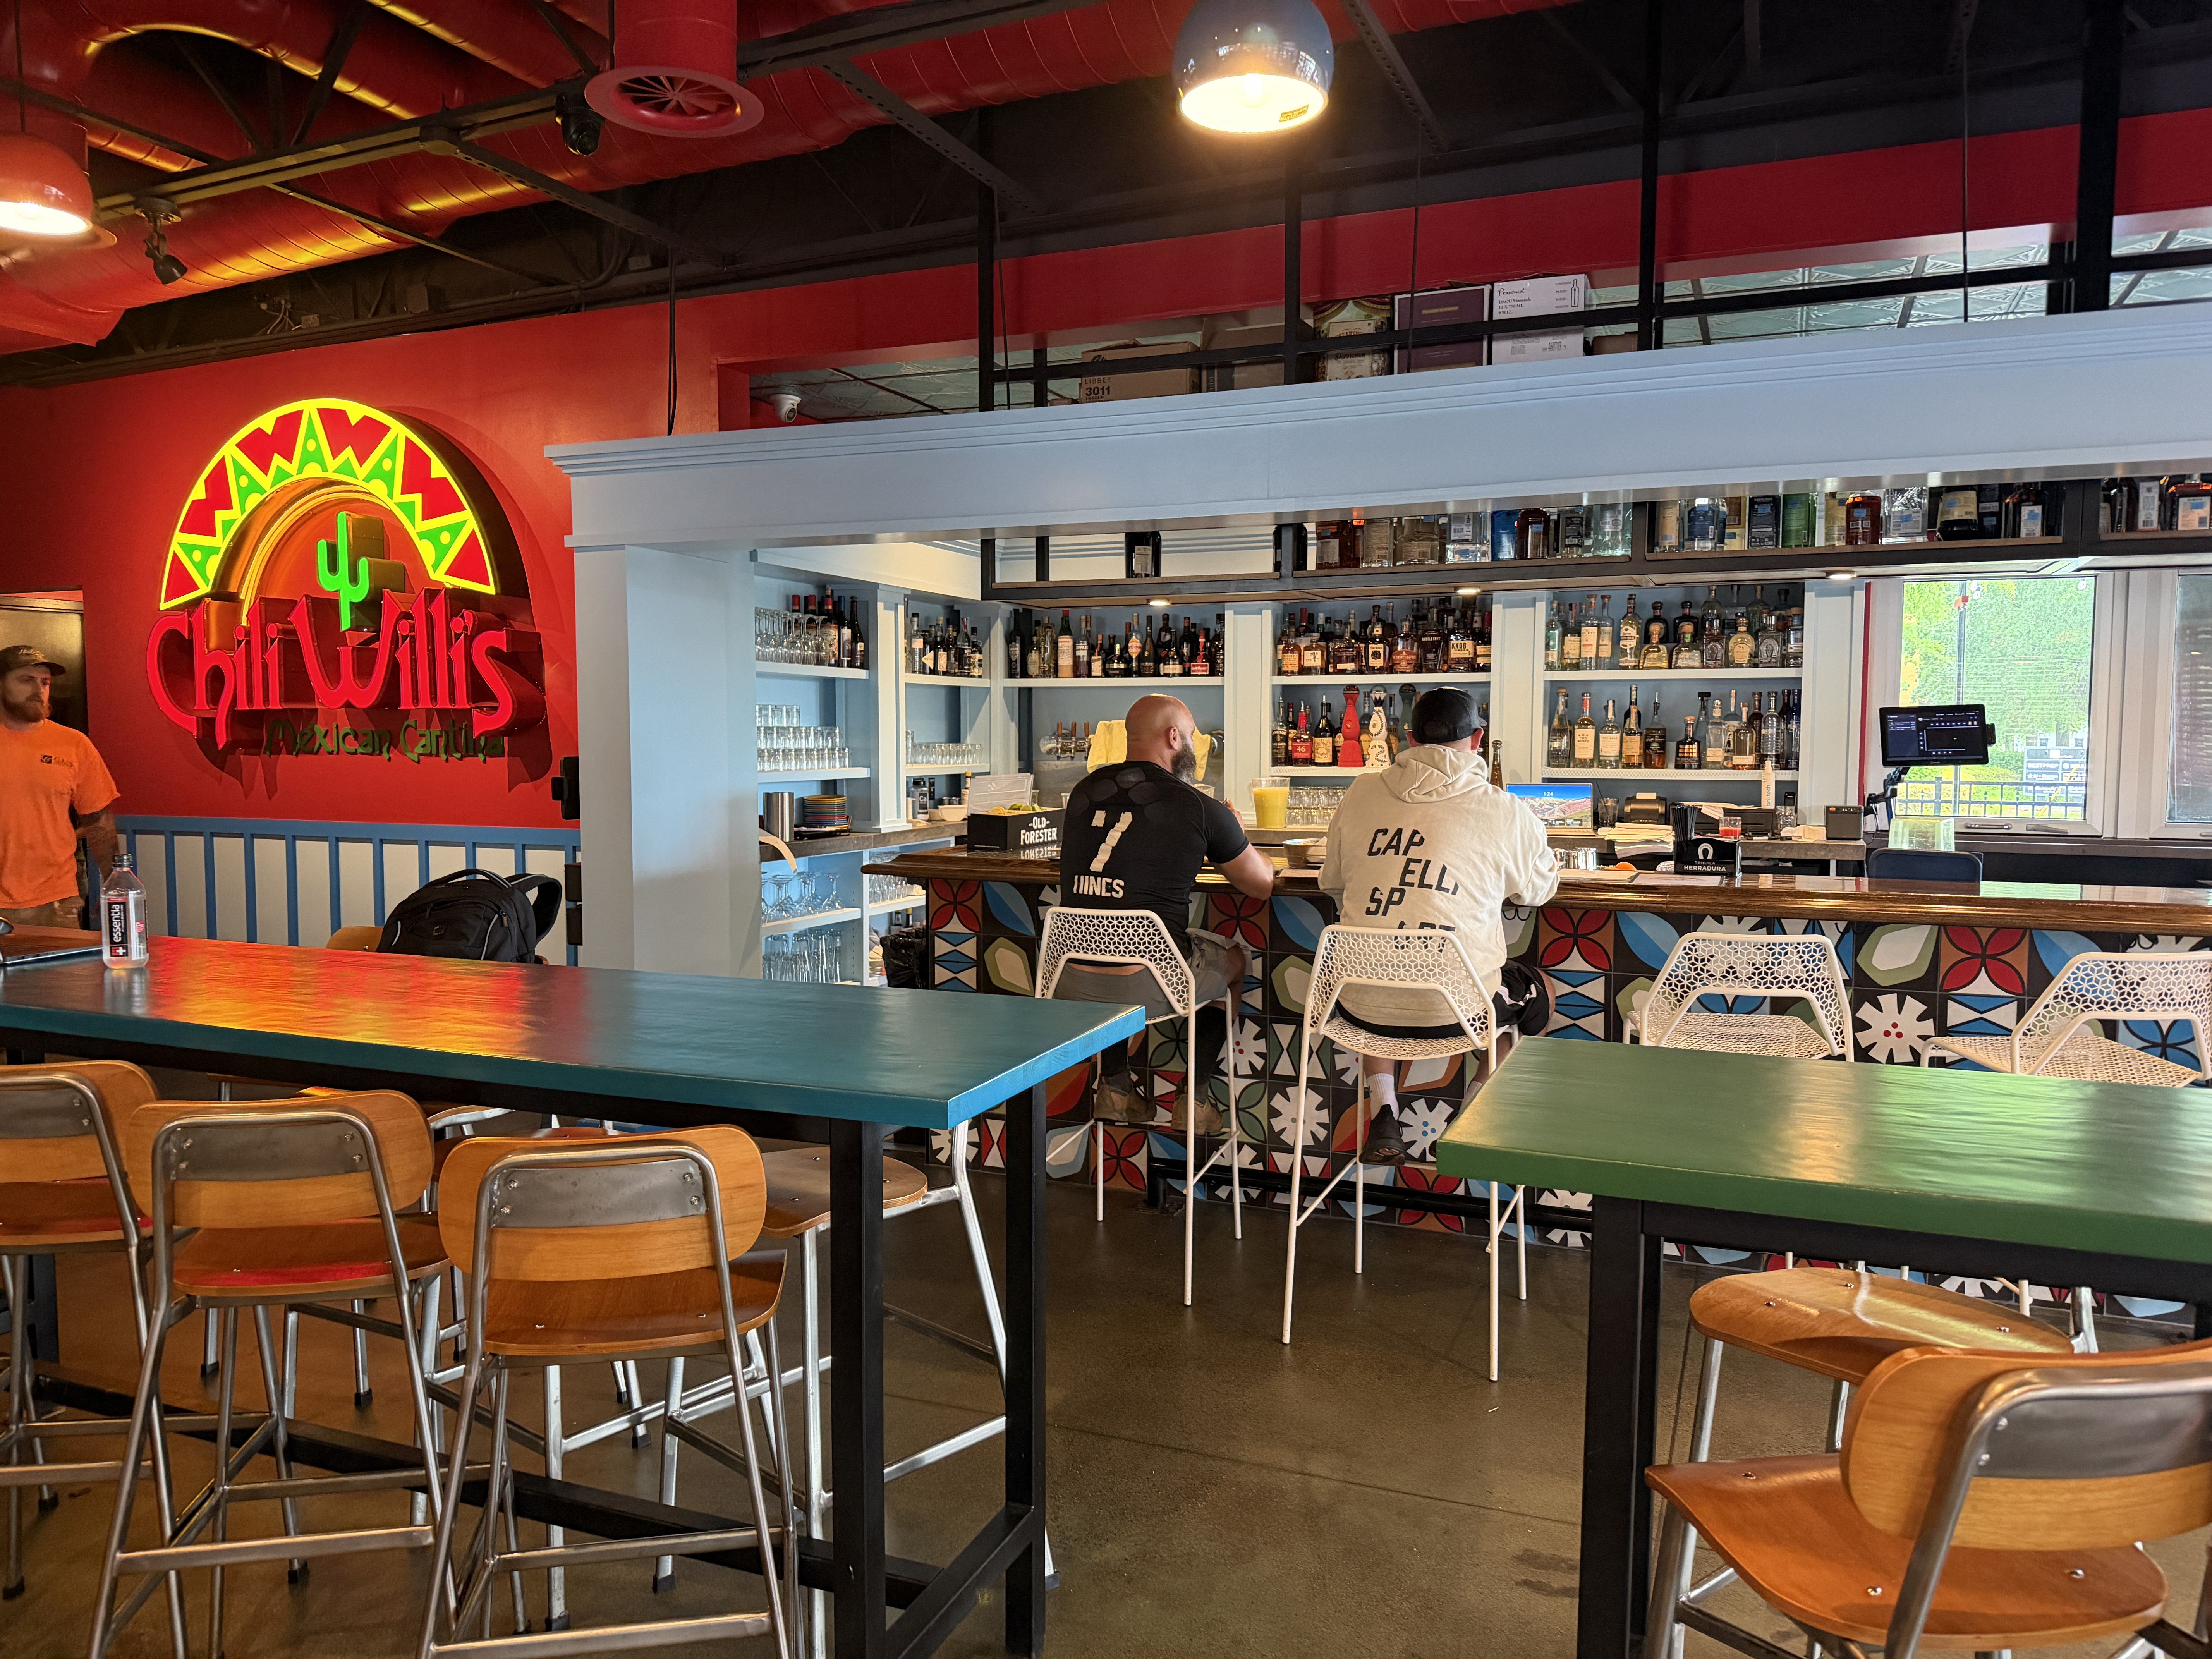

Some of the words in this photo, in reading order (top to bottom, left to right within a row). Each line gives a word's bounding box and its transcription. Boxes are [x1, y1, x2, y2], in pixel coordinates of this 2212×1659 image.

[1085, 386, 1110, 396] 3011
[147, 598, 283, 750] Chili
[264, 719, 392, 761] Mexican
[400, 719, 505, 763] Cantina
[1020, 827, 1058, 845] FORESTER
[1367, 828, 1425, 857] CAP
[1365, 886, 1406, 916] SP
[110, 904, 122, 942] essentia
